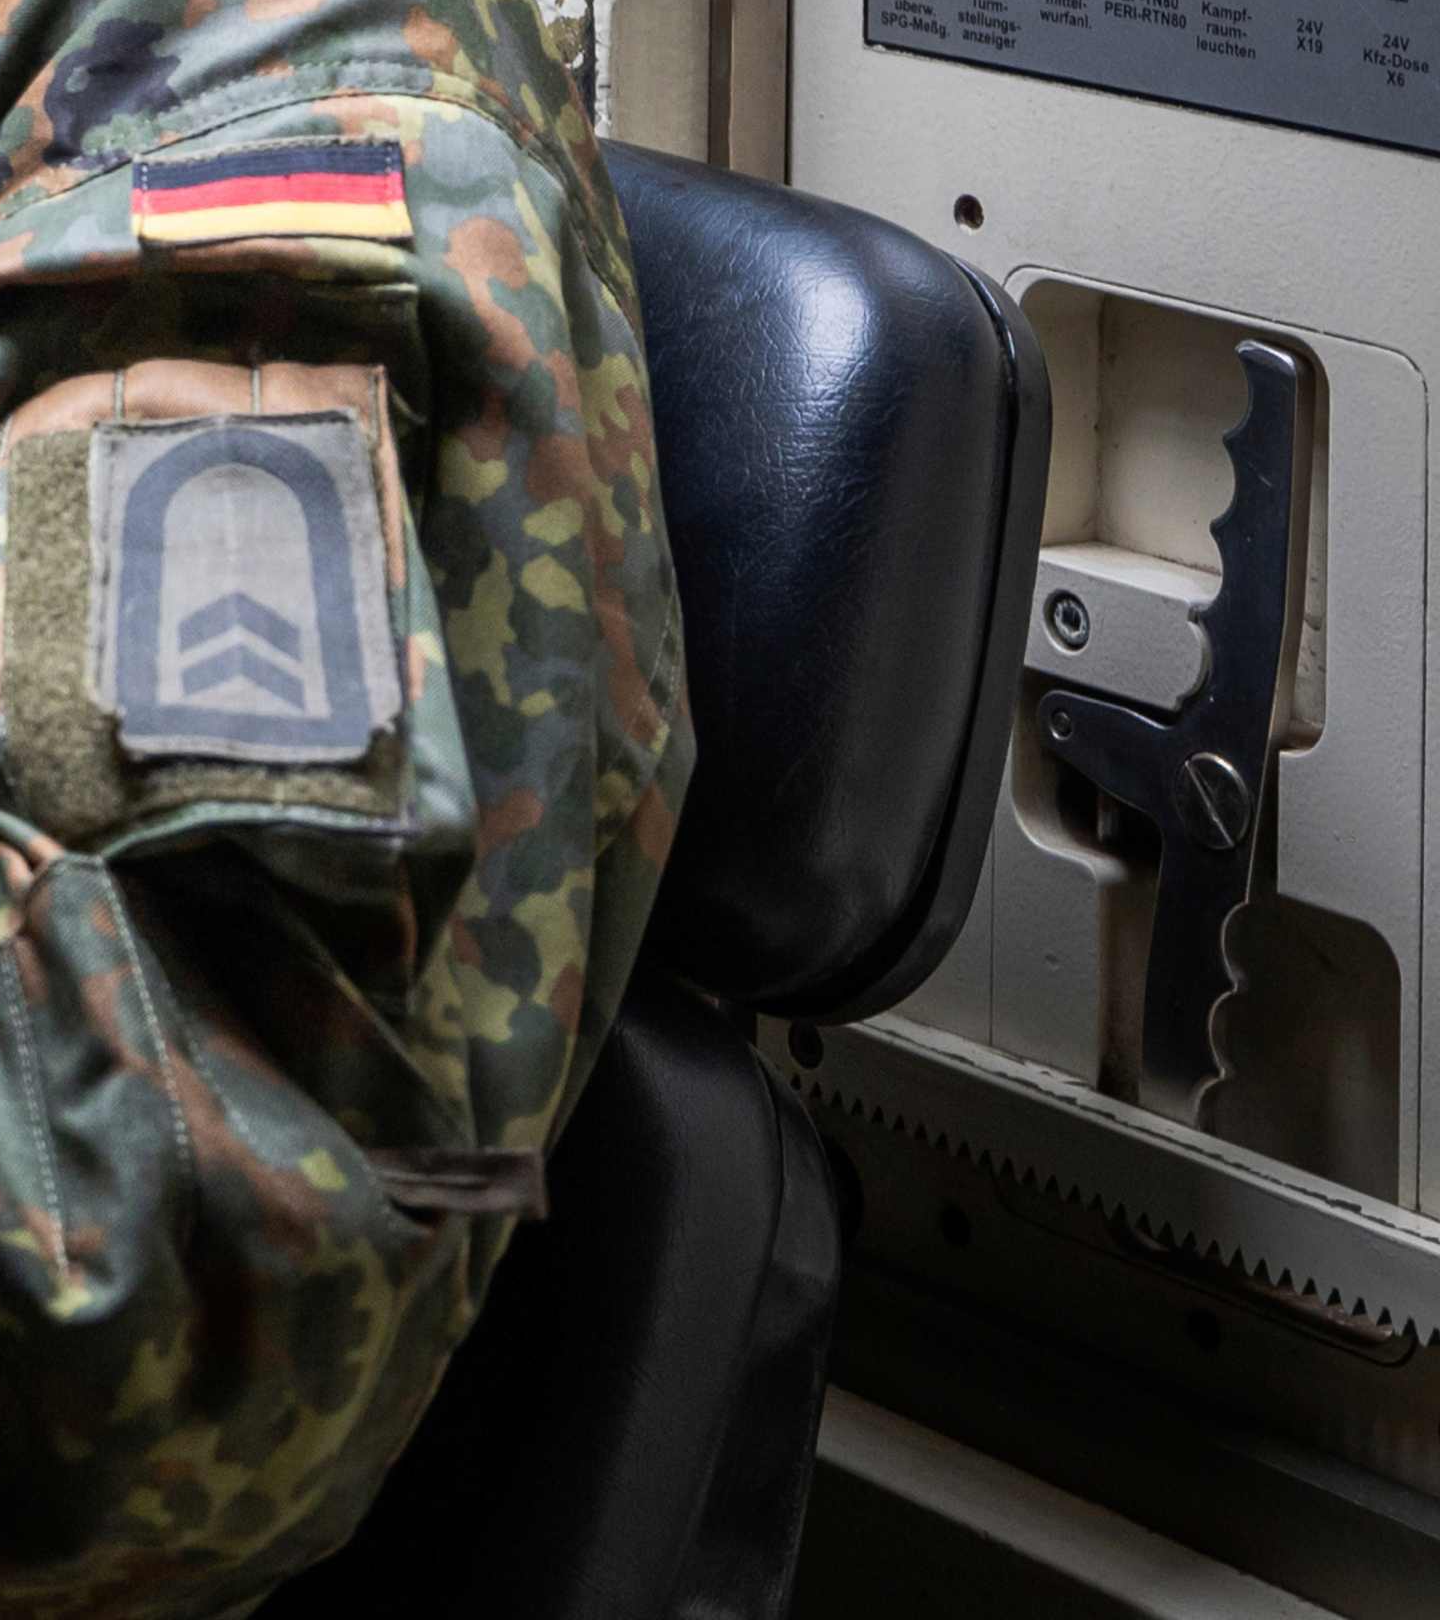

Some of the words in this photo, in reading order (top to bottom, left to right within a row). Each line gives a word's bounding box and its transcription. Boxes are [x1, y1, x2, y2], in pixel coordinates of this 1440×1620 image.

[894, 0, 936, 16] überw.
[1104, 1, 1186, 29] PERI-RTN80
[1202, 1, 1253, 24] Kampf-
[958, 11, 1022, 34] stellungs-
[1041, 11, 1092, 29] wurfanl.
[1297, 19, 1323, 36] 24V
[963, 28, 1016, 49] anzeiger
[1206, 22, 1247, 39] raum-
[1196, 37, 1256, 59] leuchten
[1297, 36, 1323, 53] X19
[1383, 34, 1410, 52] 24V
[1363, 49, 1429, 73] Kfz-Dose
[1387, 70, 1405, 87] X6
